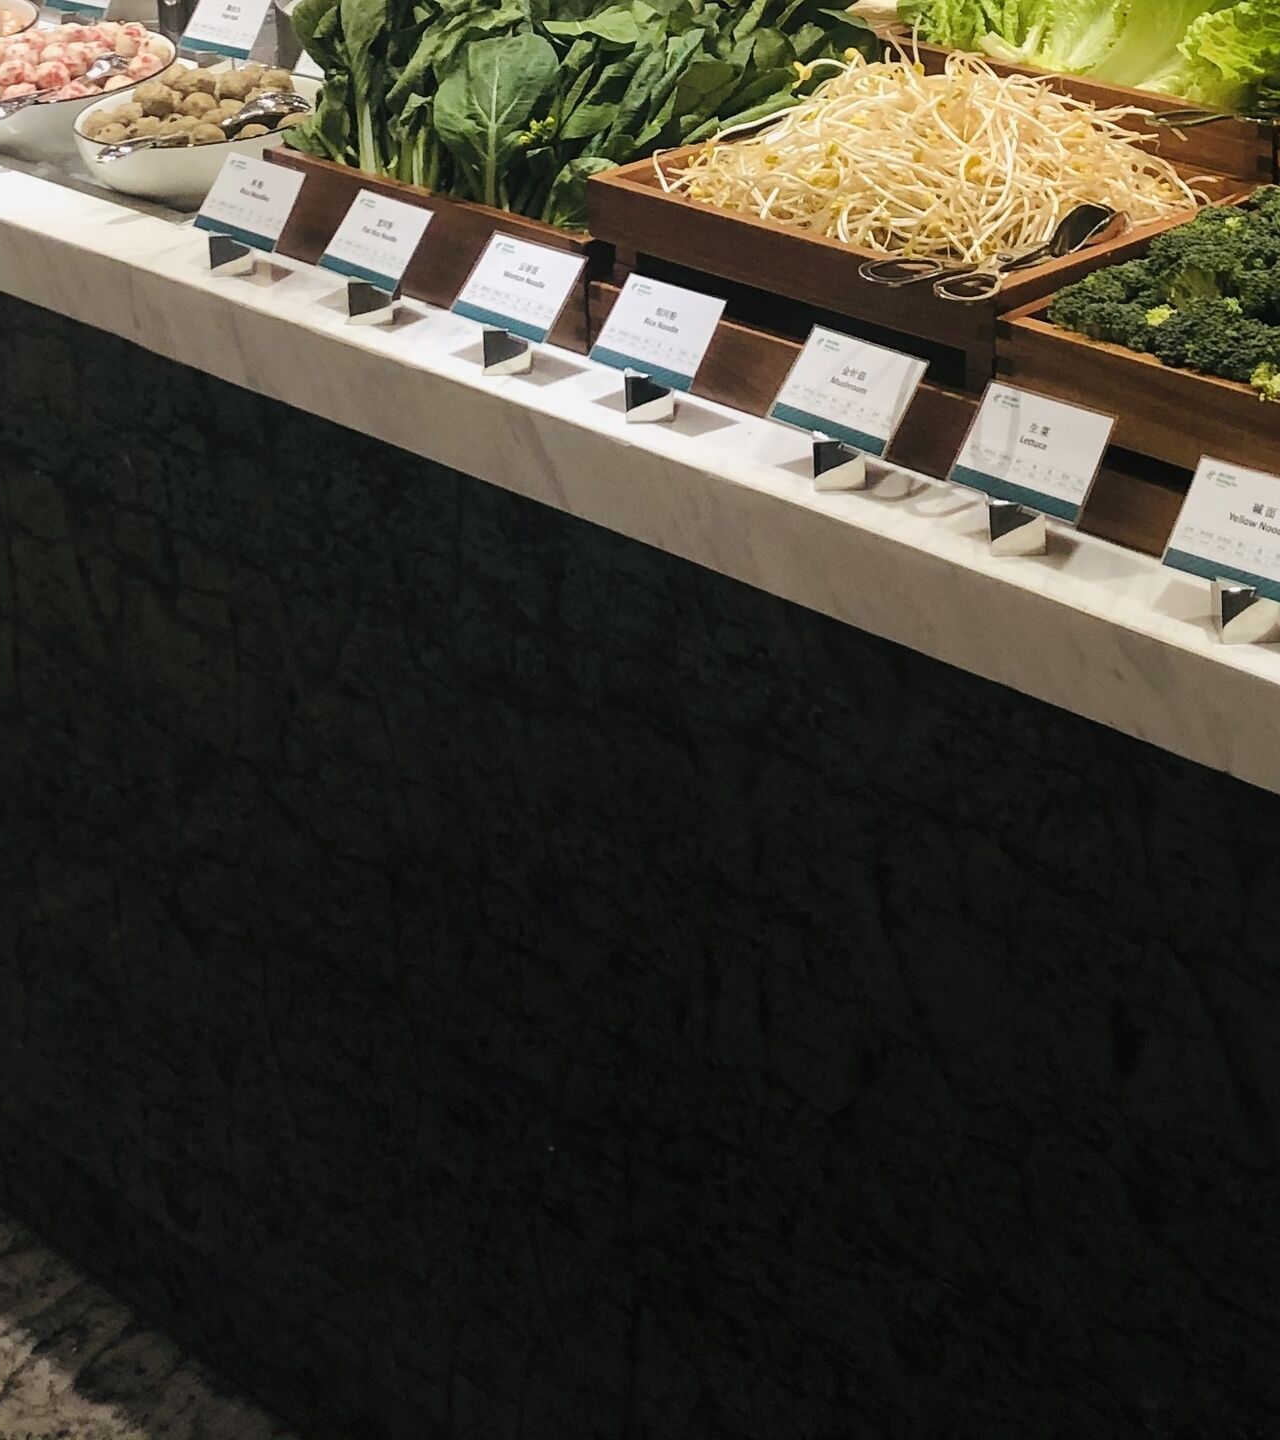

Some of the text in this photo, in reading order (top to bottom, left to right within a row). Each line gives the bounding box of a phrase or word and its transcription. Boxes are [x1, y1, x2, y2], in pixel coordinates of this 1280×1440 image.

[643, 317, 679, 334] Rice Noodle
[830, 376, 868, 394] Mushroom
[1028, 422, 1051, 438] 生菜
[1019, 435, 1048, 451] Lettuce
[1229, 511, 1258, 528] Yellow
